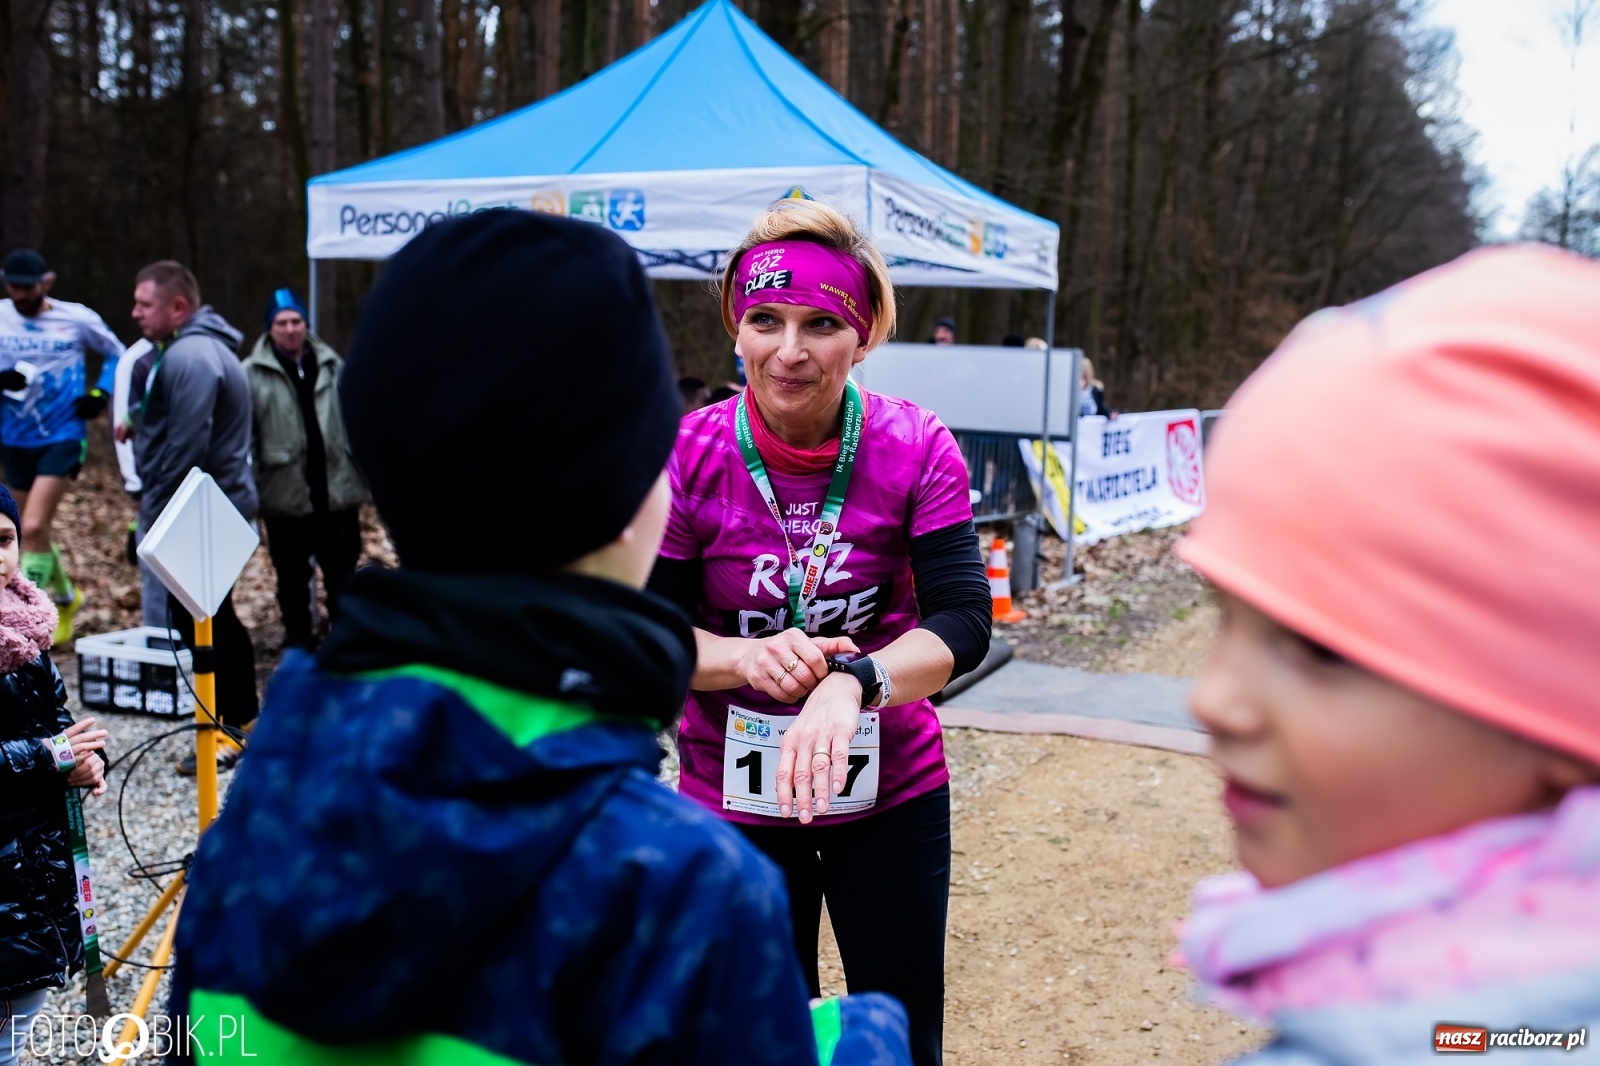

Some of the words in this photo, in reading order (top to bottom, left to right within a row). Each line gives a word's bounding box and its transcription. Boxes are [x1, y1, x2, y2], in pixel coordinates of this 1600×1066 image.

[842, 400, 855, 443] Twardziela
[849, 413, 862, 453] Raciborzu
[839, 444, 851, 463] Bieg
[848, 454, 855, 463] w
[836, 463, 844, 473] IX
[785, 501, 819, 516] JUST
[735, 749, 870, 798] 17
